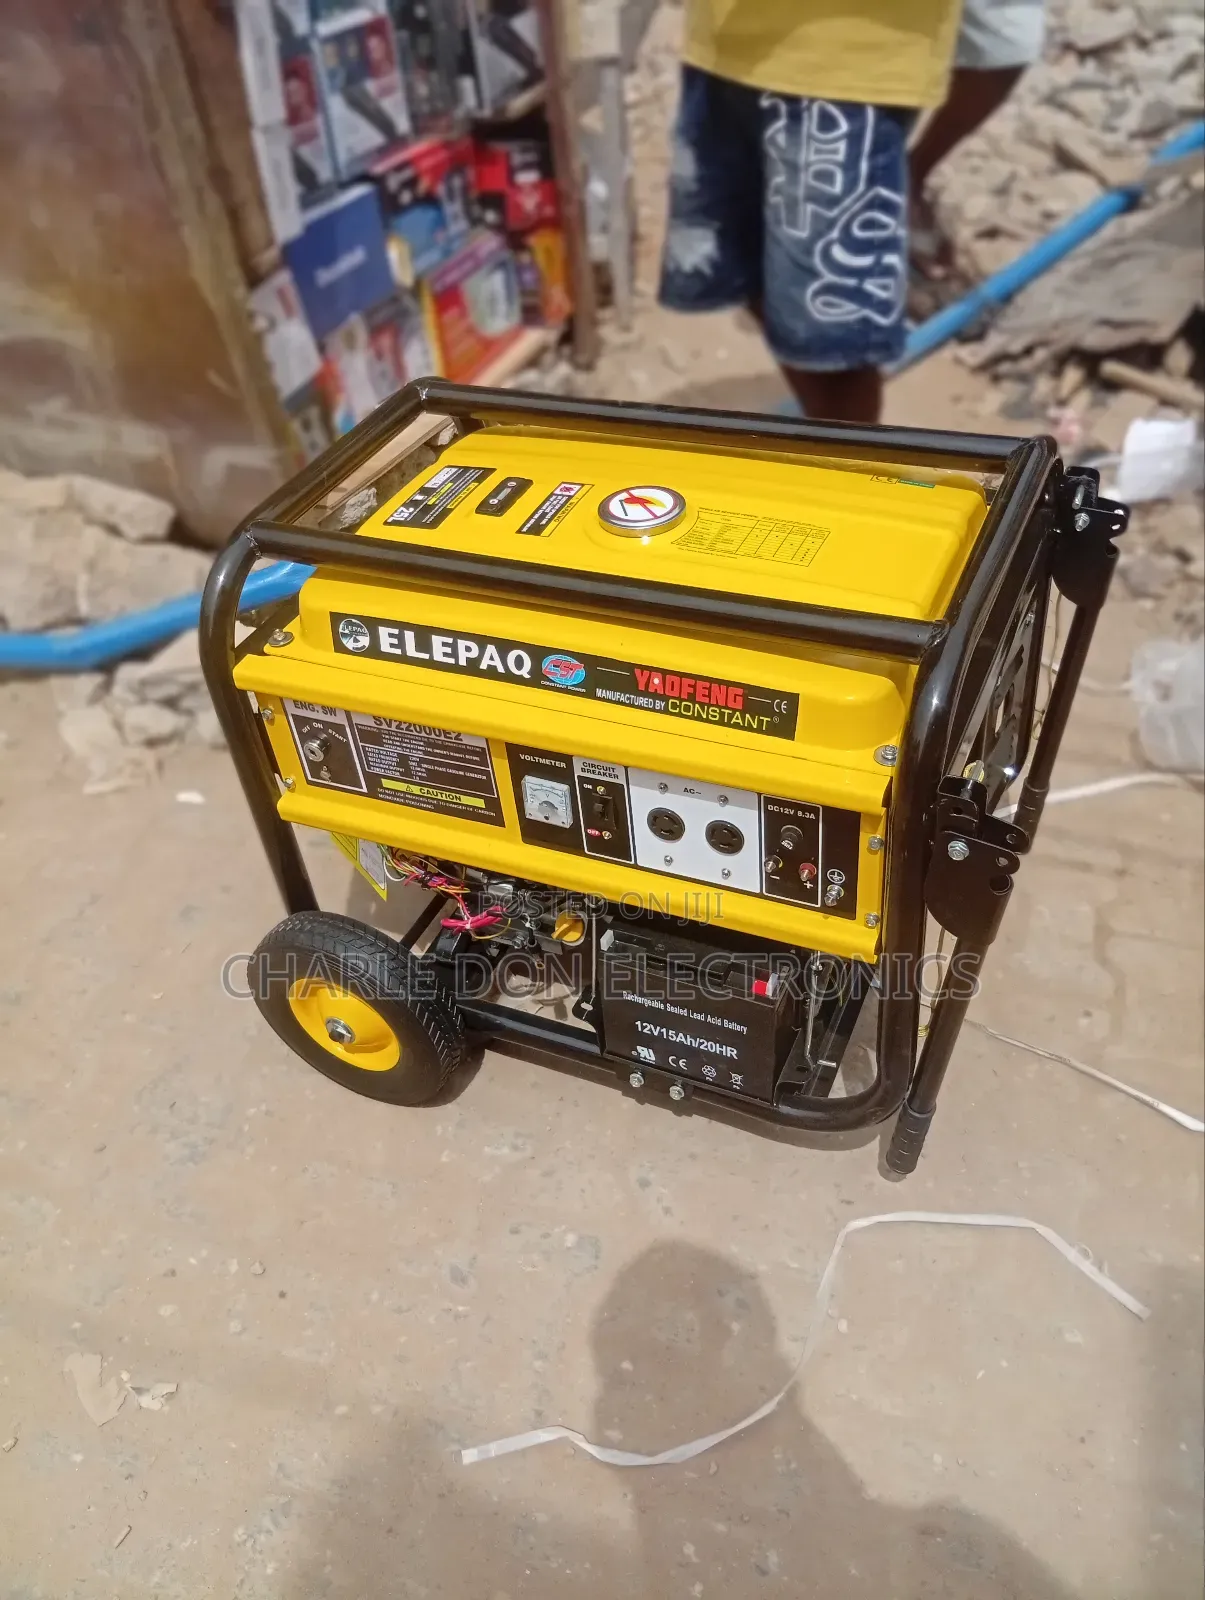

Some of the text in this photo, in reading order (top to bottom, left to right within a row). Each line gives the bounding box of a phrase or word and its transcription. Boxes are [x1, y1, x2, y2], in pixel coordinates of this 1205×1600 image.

[378, 625, 532, 679] ELEPAQ
[542, 658, 584, 679] CST
[634, 668, 744, 711] YAOFENG
[595, 688, 654, 709] MANUFACTURED
[655, 699, 665, 711] BY
[293, 700, 337, 717] ENG. SW
[312, 721, 324, 729] ON
[328, 728, 348, 742] START
[519, 753, 567, 769] VOLTMETER
[582, 761, 617, 773] CIRCUIT
[581, 767, 619, 780] BREAKER
[419, 787, 462, 803] CAUTION
[767, 804, 816, 820] DC12V 8.3A
[666, 1003, 688, 1017] Sealed
[689, 1009, 705, 1021] Lead
[706, 1014, 722, 1026] Acid
[723, 1019, 748, 1035] Battery
[634, 1020, 739, 1060] 12V15Ah/20HR
